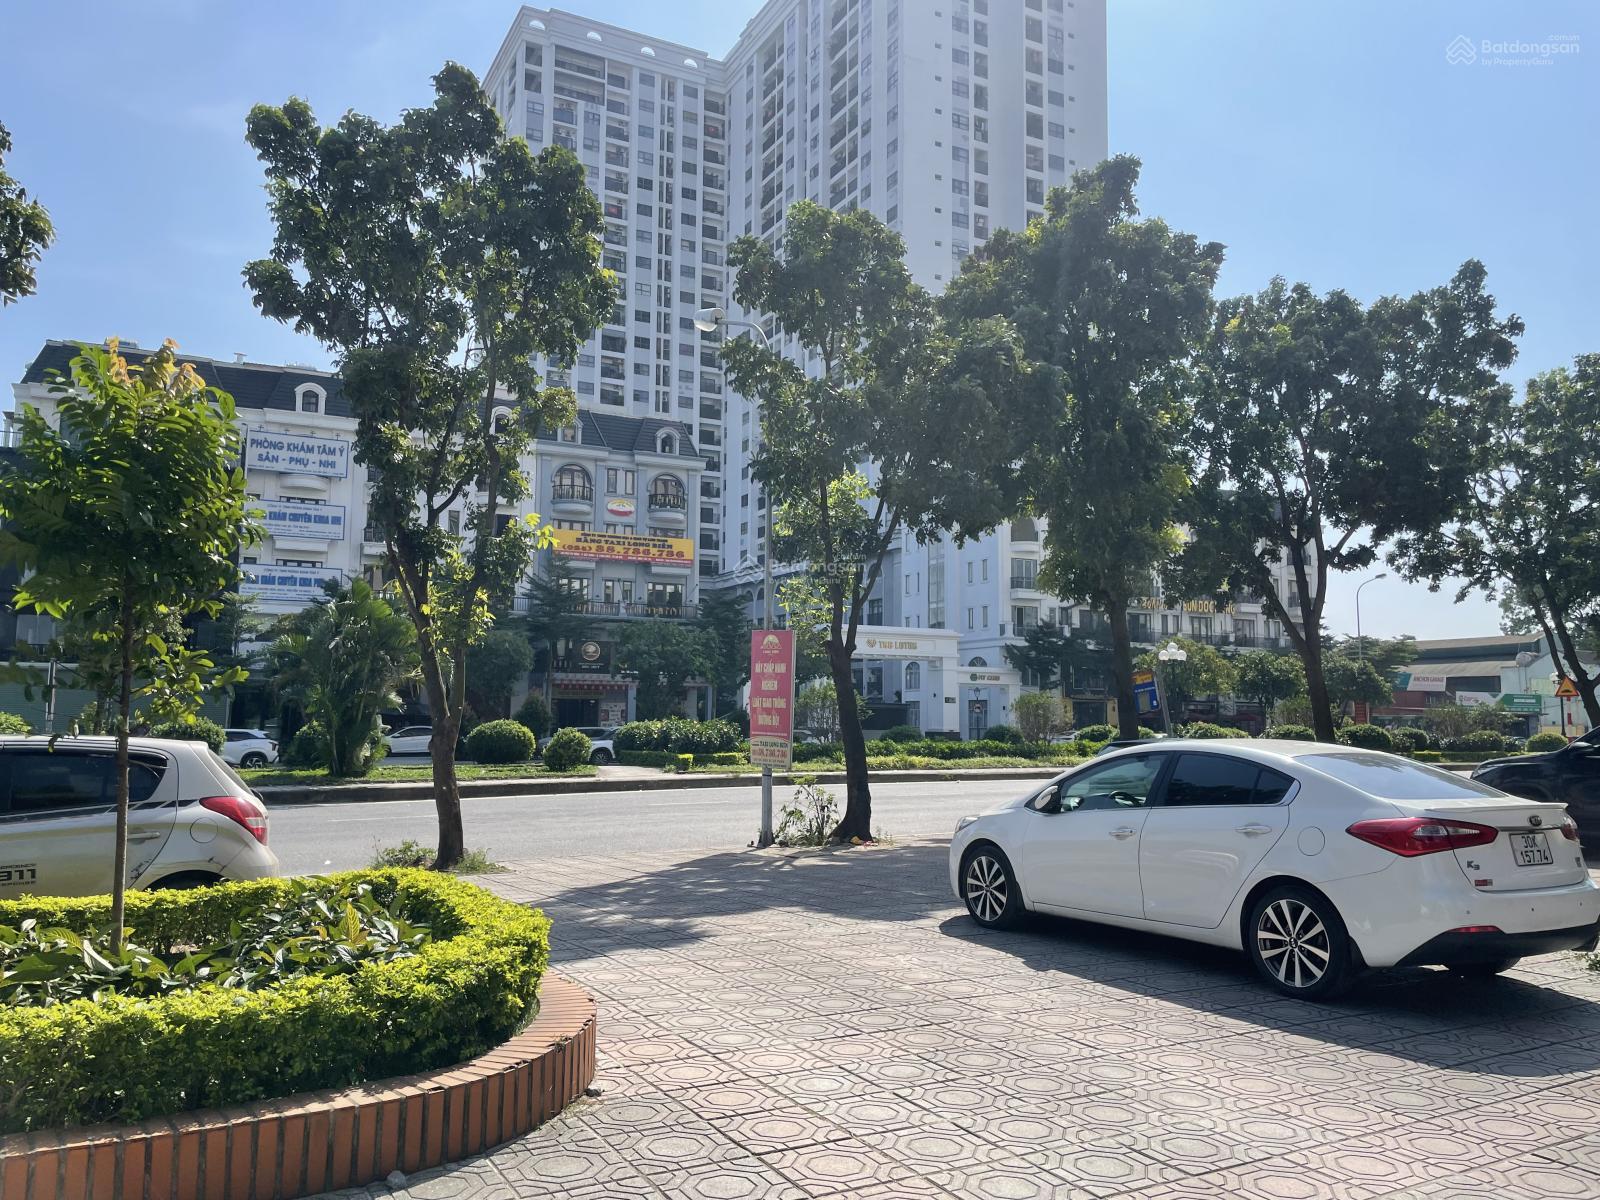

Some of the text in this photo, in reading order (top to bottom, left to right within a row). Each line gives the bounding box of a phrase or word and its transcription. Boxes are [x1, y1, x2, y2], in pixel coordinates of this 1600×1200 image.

[250, 437, 284, 451] PHÒNG
[286, 440, 314, 454] KHÁM
[317, 444, 336, 457] TÂM
[257, 451, 279, 463] SẢN
[289, 456, 309, 468] PHỤ
[319, 459, 337, 469] NHI
[576, 536, 602, 544] HÃNG
[652, 541, 673, 549] BIÊN
[1521, 836, 1538, 849] 30K
[1520, 850, 1549, 864] 157.74
